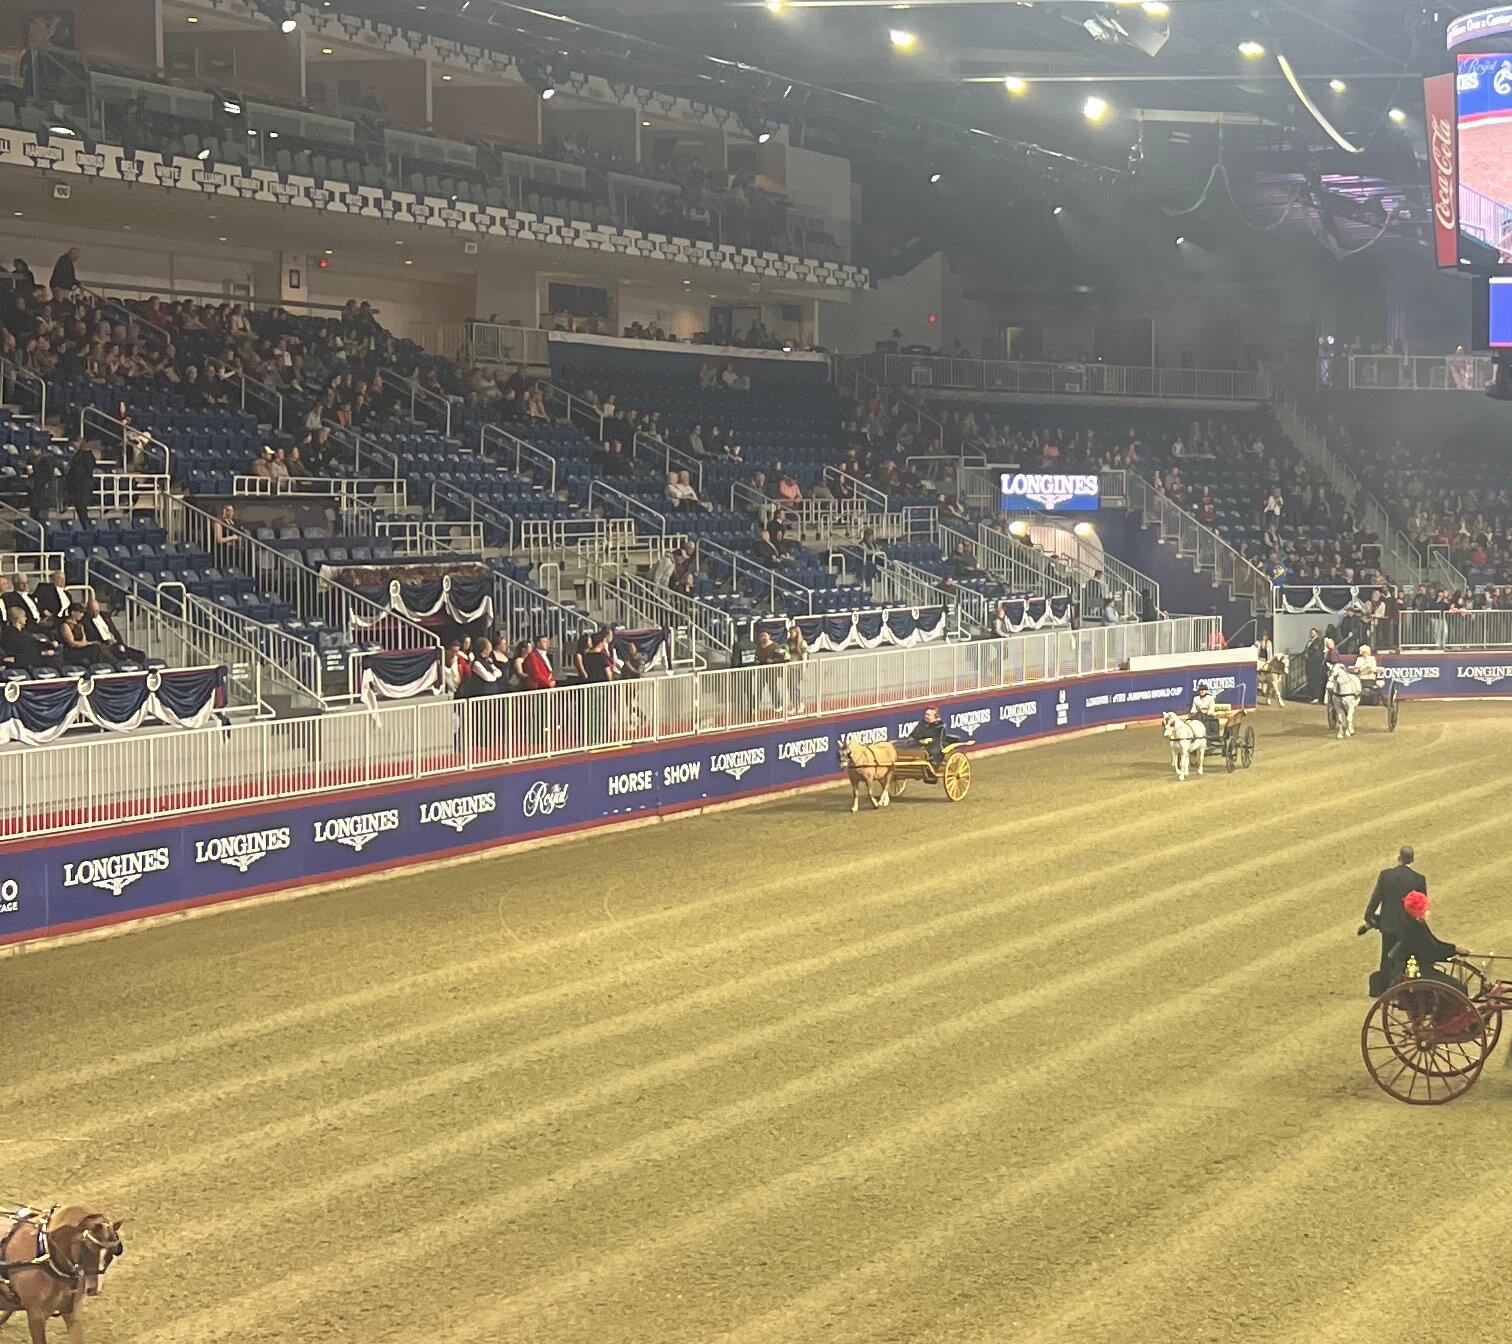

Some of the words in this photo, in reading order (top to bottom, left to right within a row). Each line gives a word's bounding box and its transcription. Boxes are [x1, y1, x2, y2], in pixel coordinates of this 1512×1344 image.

[1001, 474, 1098, 495] LONGINES
[951, 709, 990, 728] LONGINES
[1000, 701, 1037, 720] LONGINES
[710, 747, 765, 774] LONGINES
[778, 736, 828, 759] LONGINES
[608, 770, 652, 796] HORSE
[663, 761, 701, 786] SHOW
[420, 792, 496, 824] LONGINES
[523, 781, 569, 817] Royal
[314, 809, 399, 843] LONGINES
[195, 827, 290, 863] LONGINES
[64, 847, 169, 887] LONGINES
